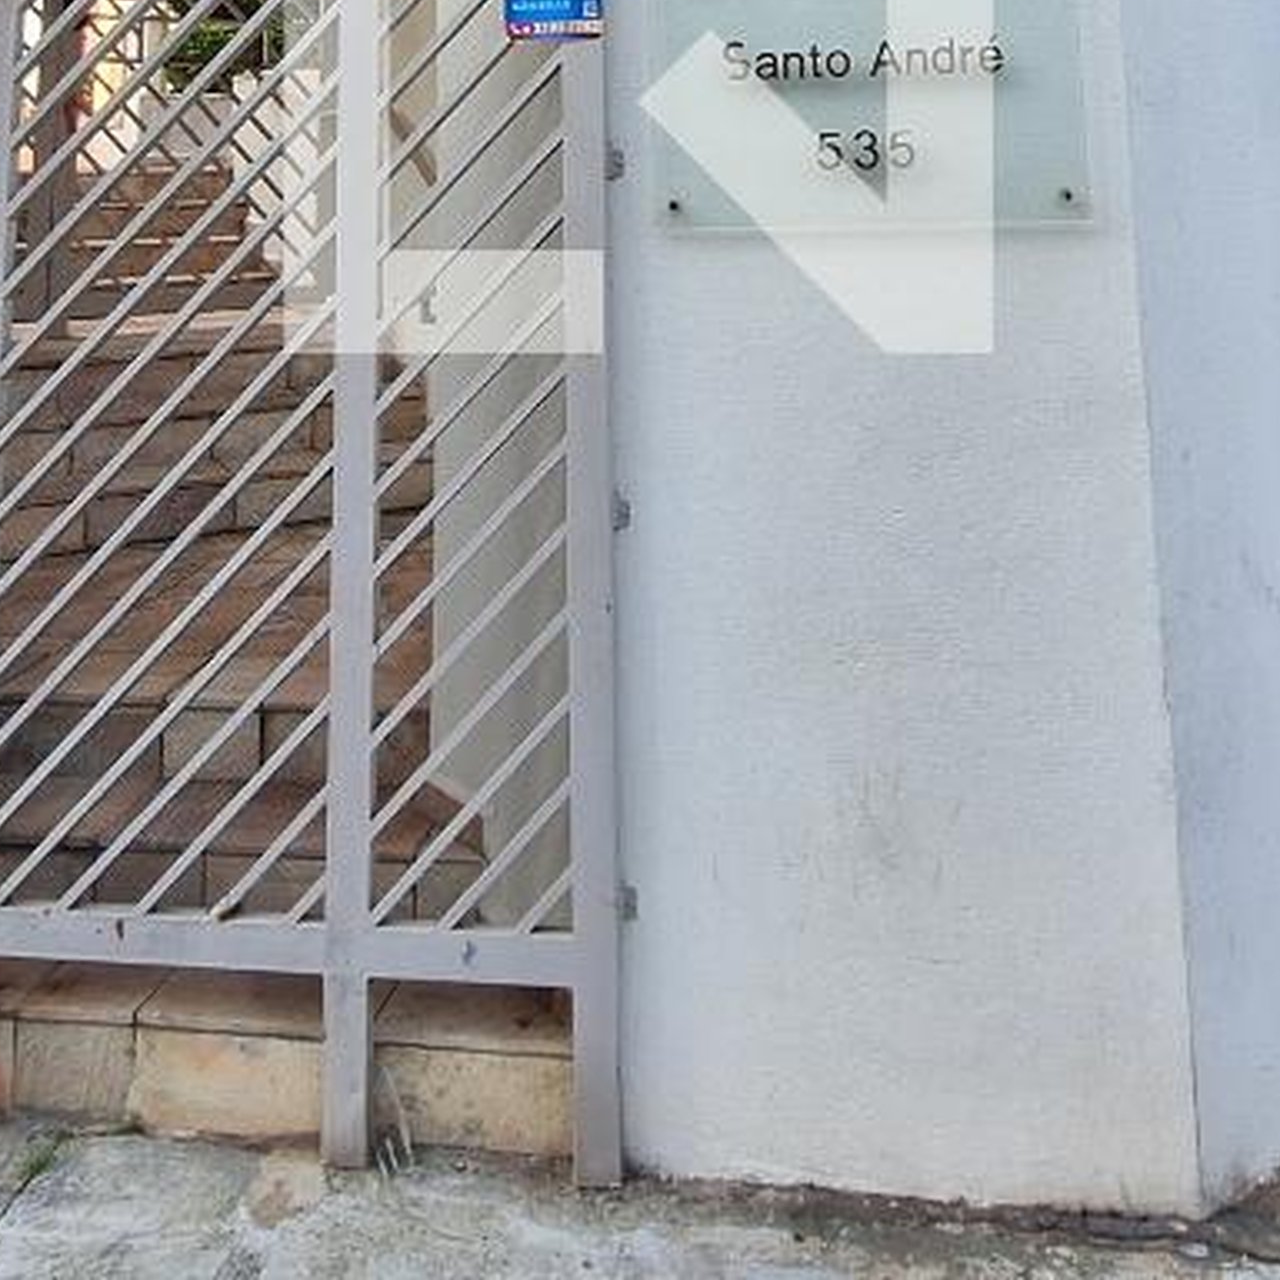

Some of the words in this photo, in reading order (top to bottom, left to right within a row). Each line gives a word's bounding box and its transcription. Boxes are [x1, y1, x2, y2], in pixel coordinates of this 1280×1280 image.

[722, 40, 852, 81] Santo
[869, 34, 1005, 80] André
[816, 128, 915, 170] 535
